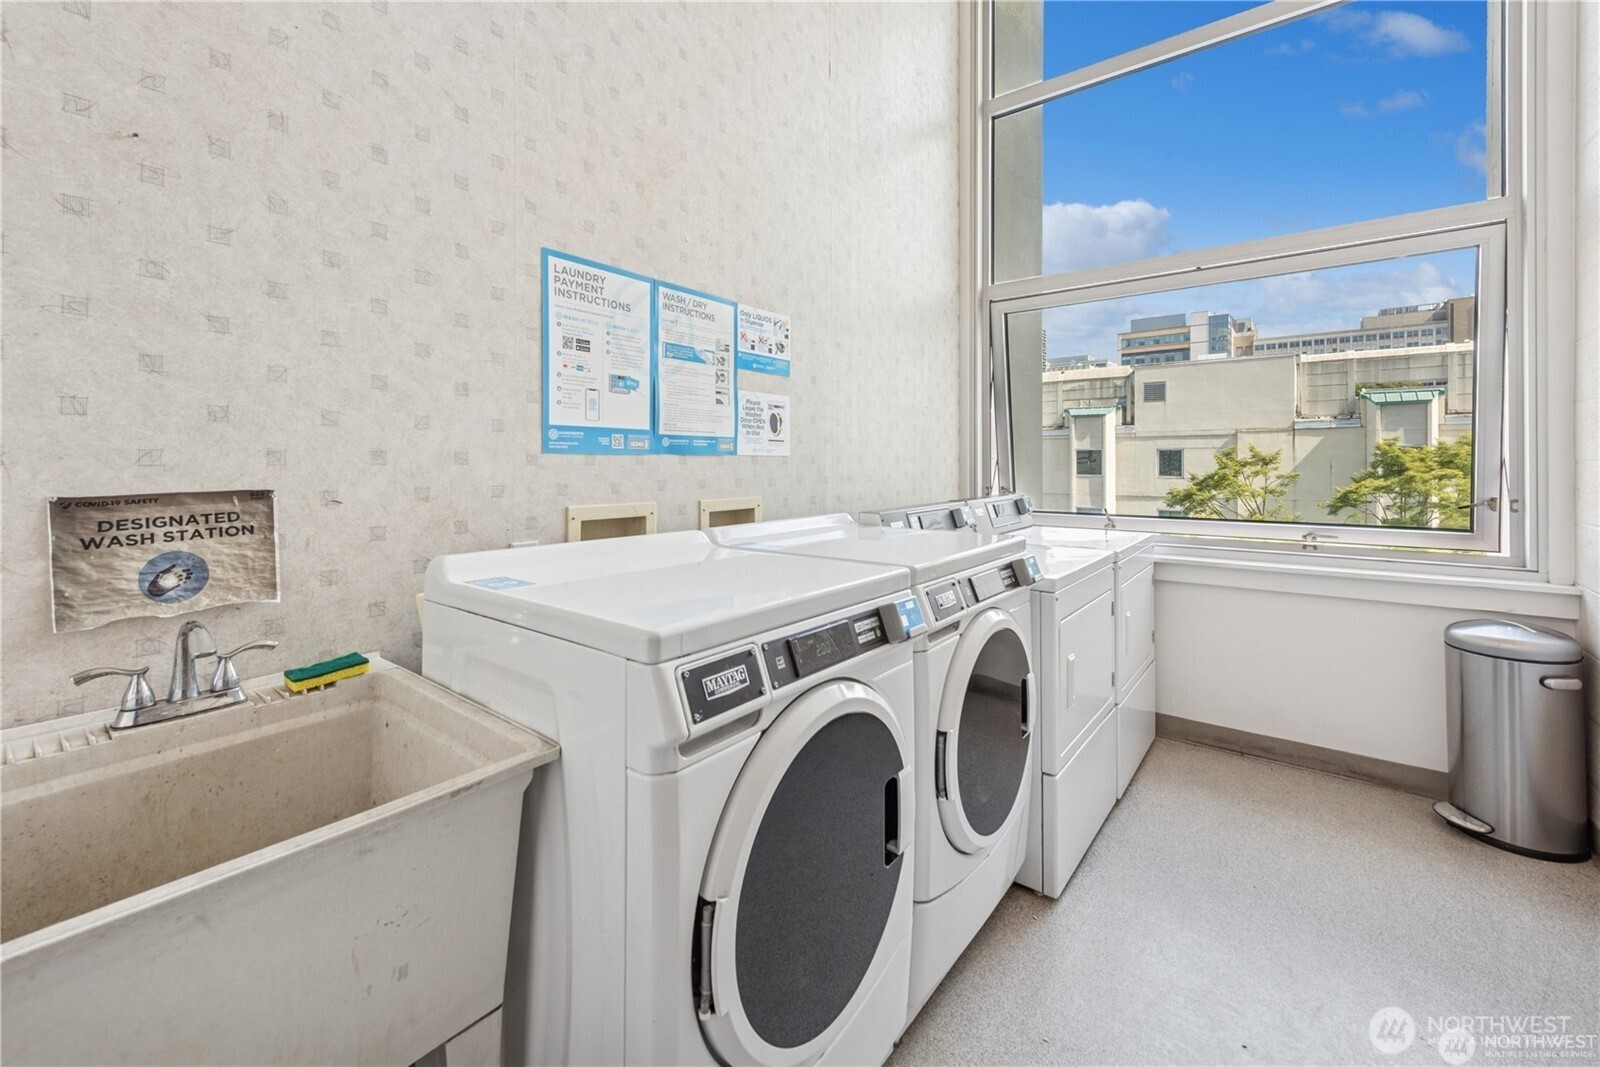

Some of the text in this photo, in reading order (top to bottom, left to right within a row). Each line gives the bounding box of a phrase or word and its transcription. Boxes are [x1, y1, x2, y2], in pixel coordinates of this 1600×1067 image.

[553, 263, 606, 285] LAUNDRY
[554, 275, 605, 296] PAYMENT
[554, 287, 632, 313] INSTRUCTIONS
[662, 291, 686, 305] WASH
[693, 299, 708, 310] DRY
[662, 302, 716, 322] INSTRUCTIONS
[740, 310, 772, 323] Only LIQUIDS
[75, 497, 159, 508] COVID-19 SAFETY
[97, 511, 241, 533] DESIGNATED
[80, 525, 255, 551] WASH STATION
[706, 668, 746, 693] MAYTAG
